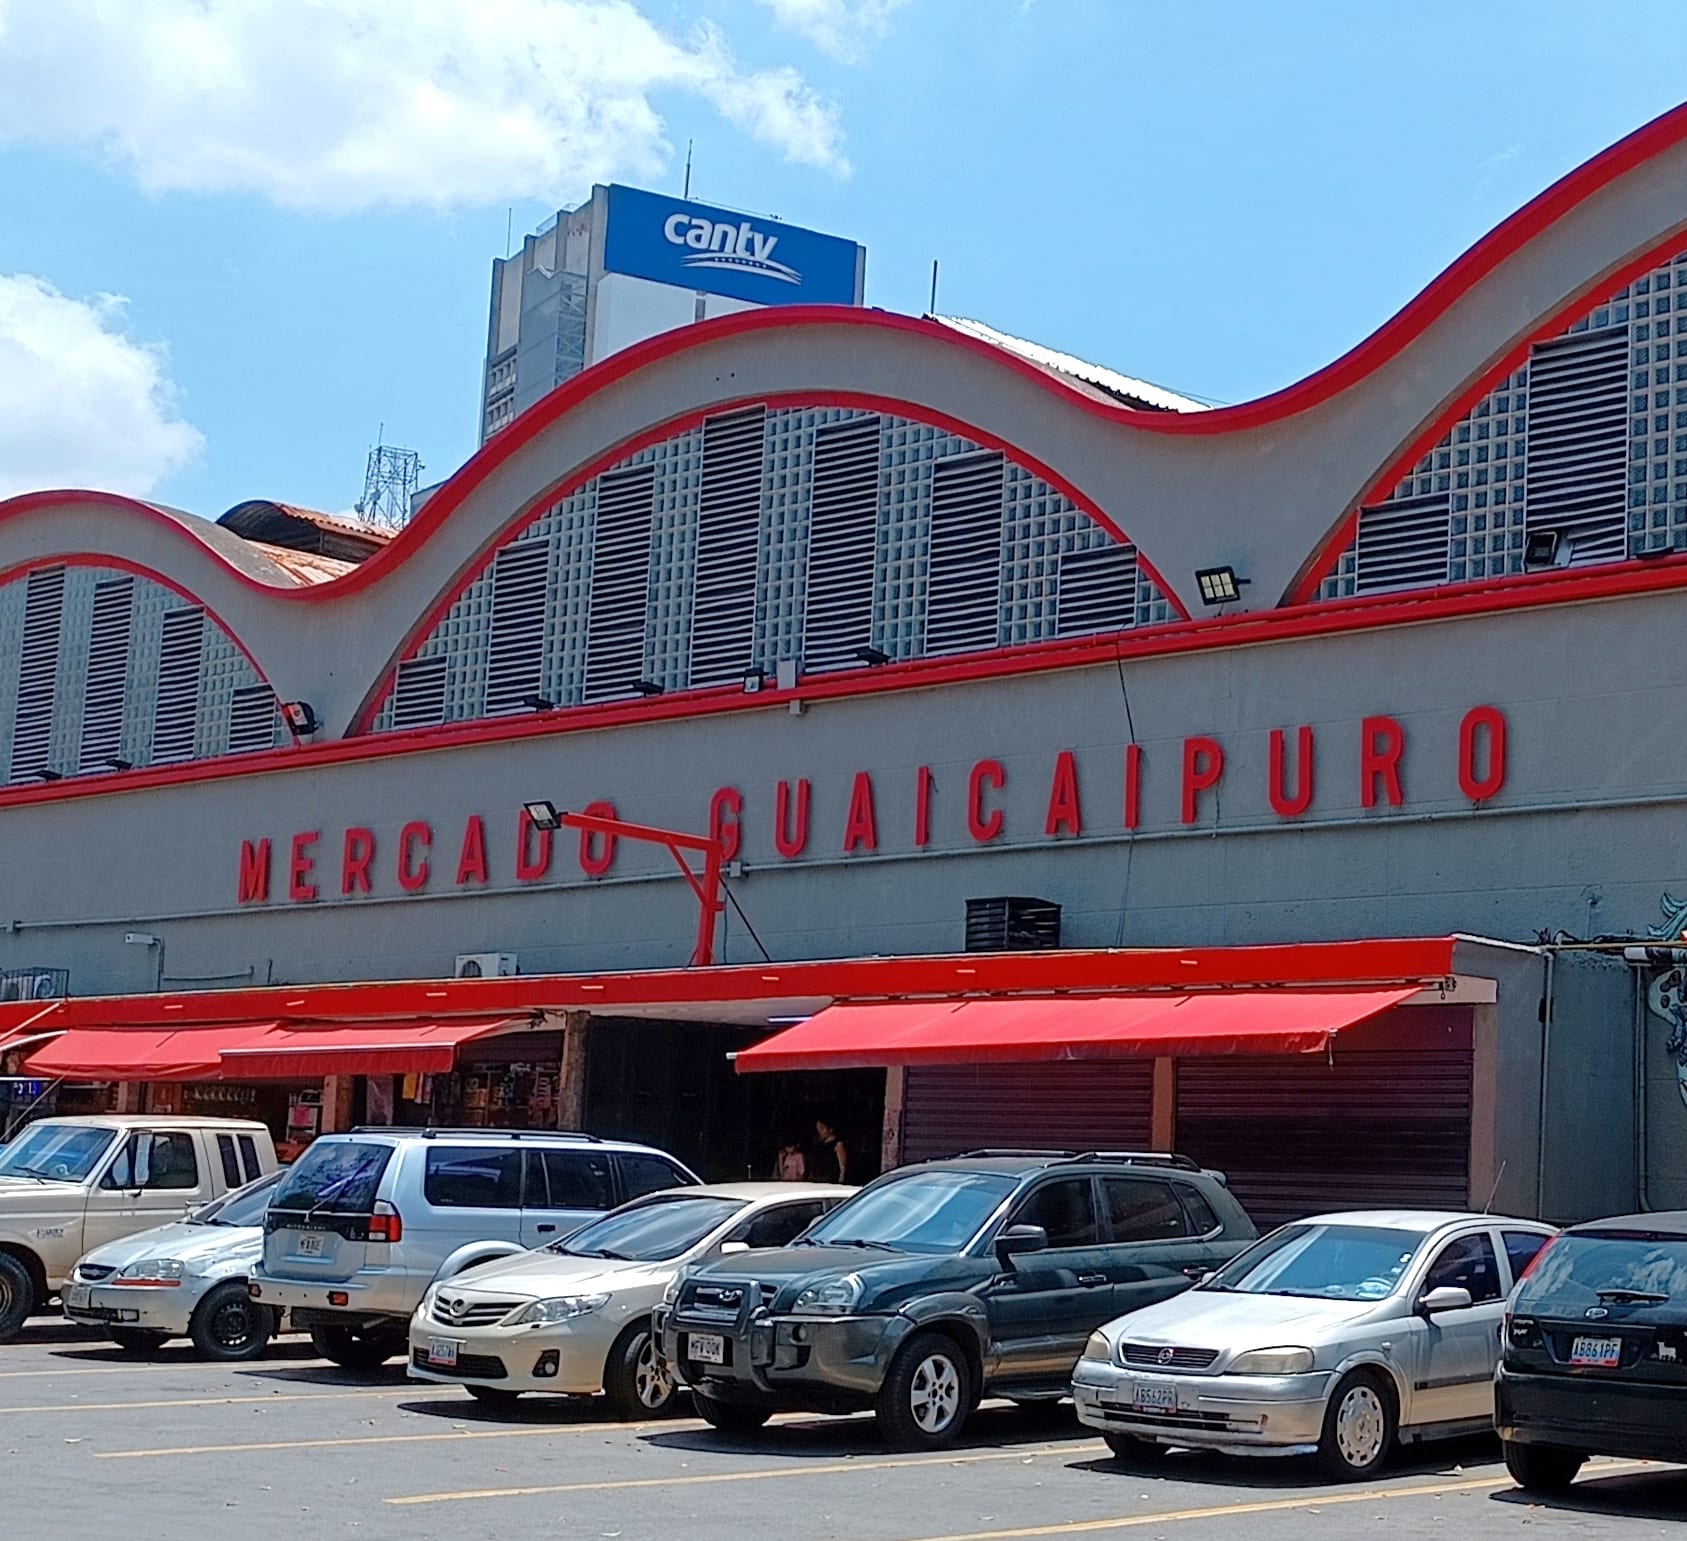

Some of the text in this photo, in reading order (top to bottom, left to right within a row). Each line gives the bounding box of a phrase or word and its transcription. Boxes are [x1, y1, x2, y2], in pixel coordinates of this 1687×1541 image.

[664, 213, 778, 261] cantv
[237, 705, 1507, 904] MERCADO GUAICAIPURO
